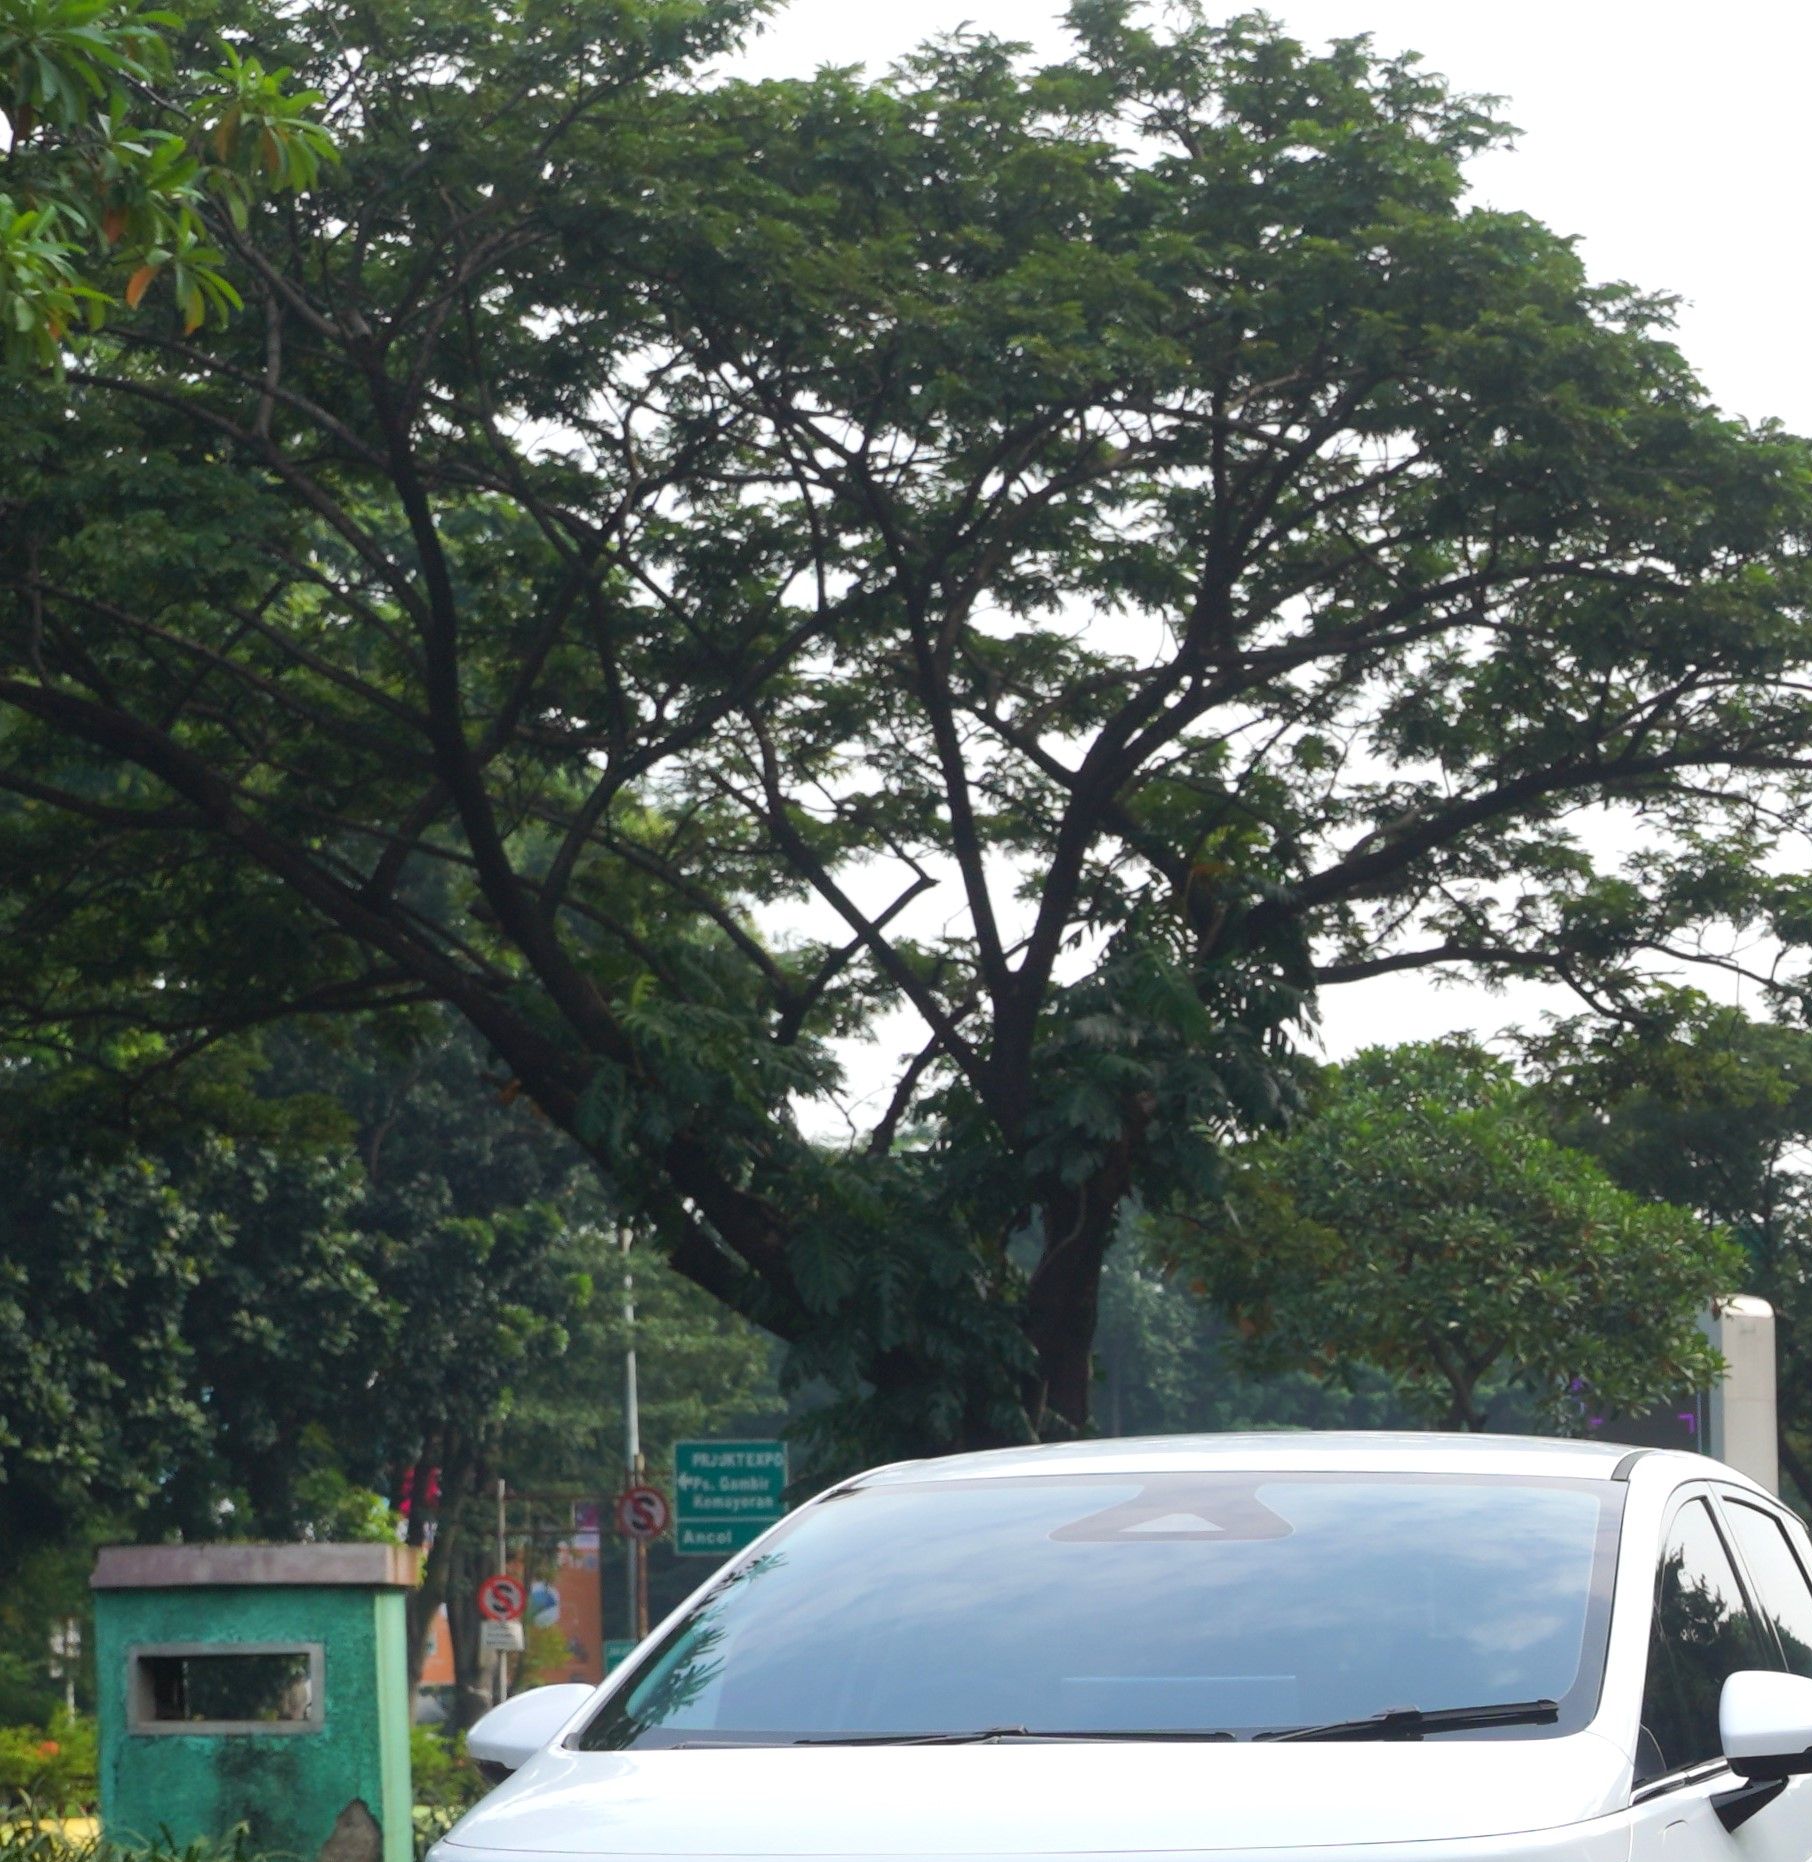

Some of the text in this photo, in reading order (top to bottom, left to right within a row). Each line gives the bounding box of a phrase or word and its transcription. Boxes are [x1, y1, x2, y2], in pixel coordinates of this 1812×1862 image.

[720, 1476, 769, 1491] Gambir
[693, 1495, 774, 1512] Kemayoran
[683, 1530, 732, 1544] Ancol
